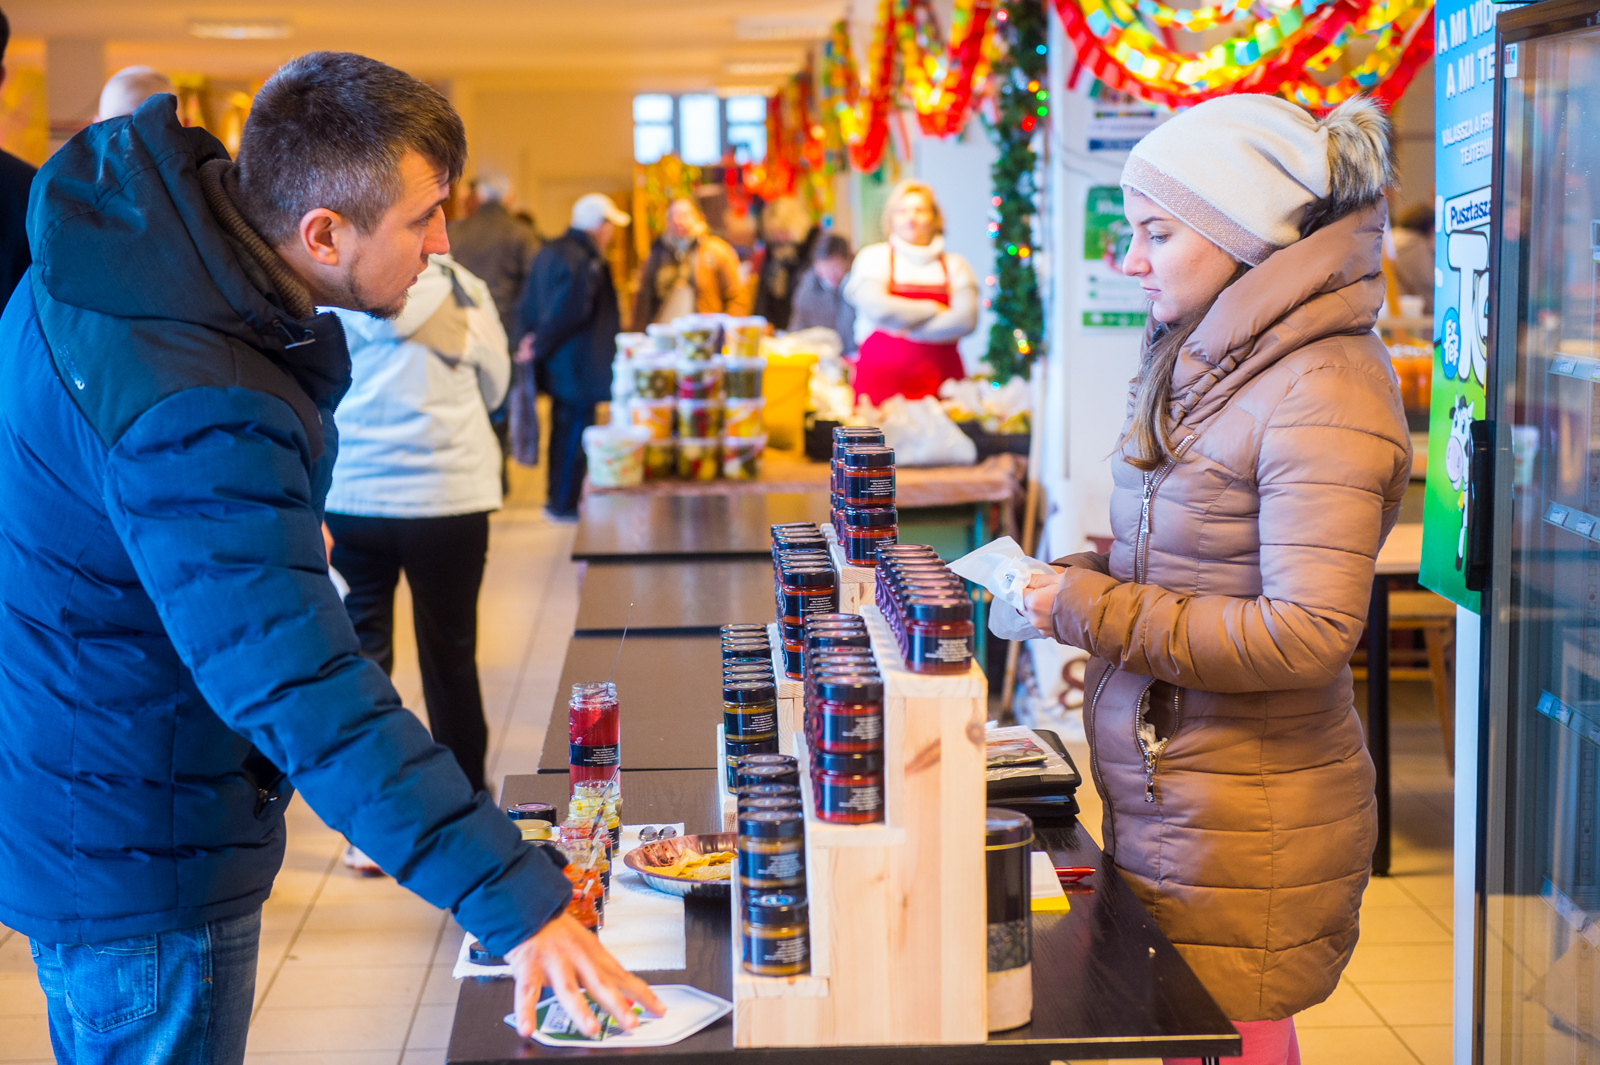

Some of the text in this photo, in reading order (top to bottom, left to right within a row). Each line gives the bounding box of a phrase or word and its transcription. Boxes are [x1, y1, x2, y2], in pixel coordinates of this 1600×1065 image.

[1438, 19, 1448, 54] A
[1450, 8, 1467, 48] MI
[1446, 63, 1456, 98] A
[1458, 53, 1474, 92] MI
